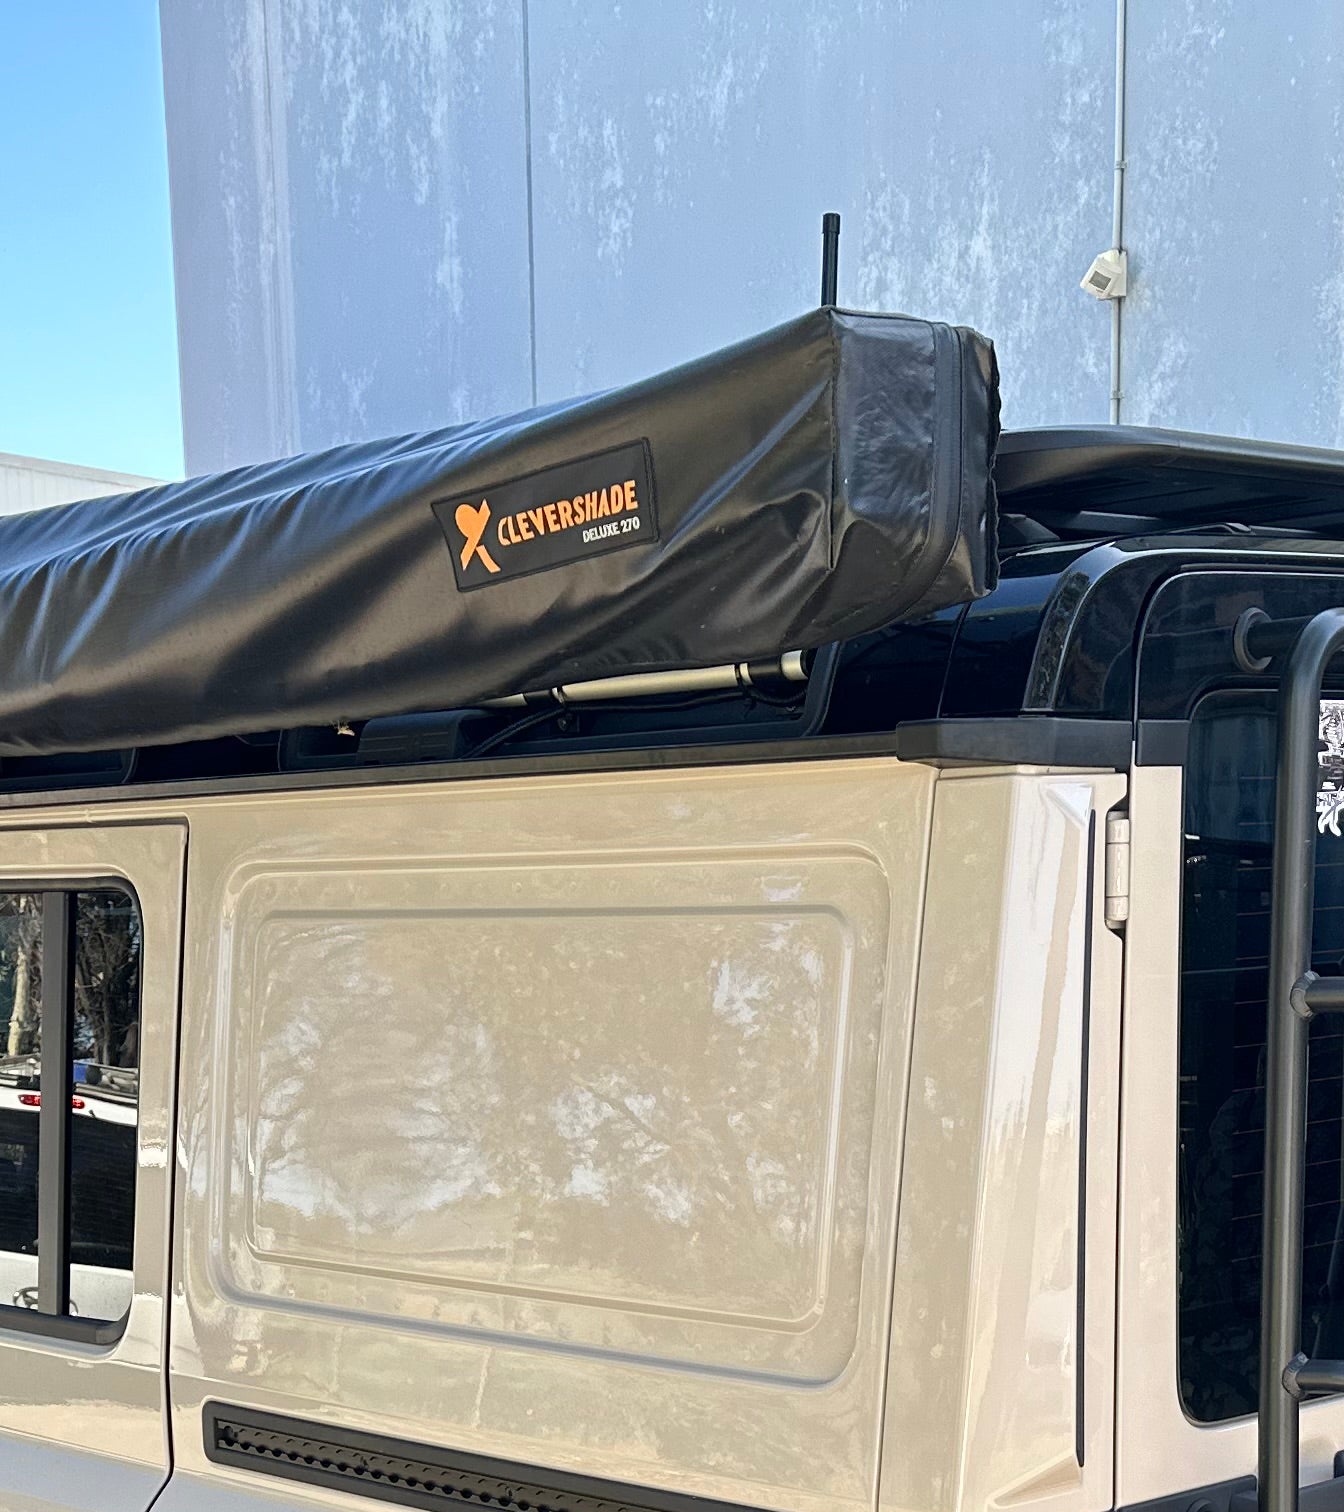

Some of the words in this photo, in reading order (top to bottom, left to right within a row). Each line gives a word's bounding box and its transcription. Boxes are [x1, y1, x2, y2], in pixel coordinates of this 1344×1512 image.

[497, 480, 639, 546] CLEVERSHADE
[582, 521, 621, 543] DELUXE
[621, 516, 641, 534] 270
